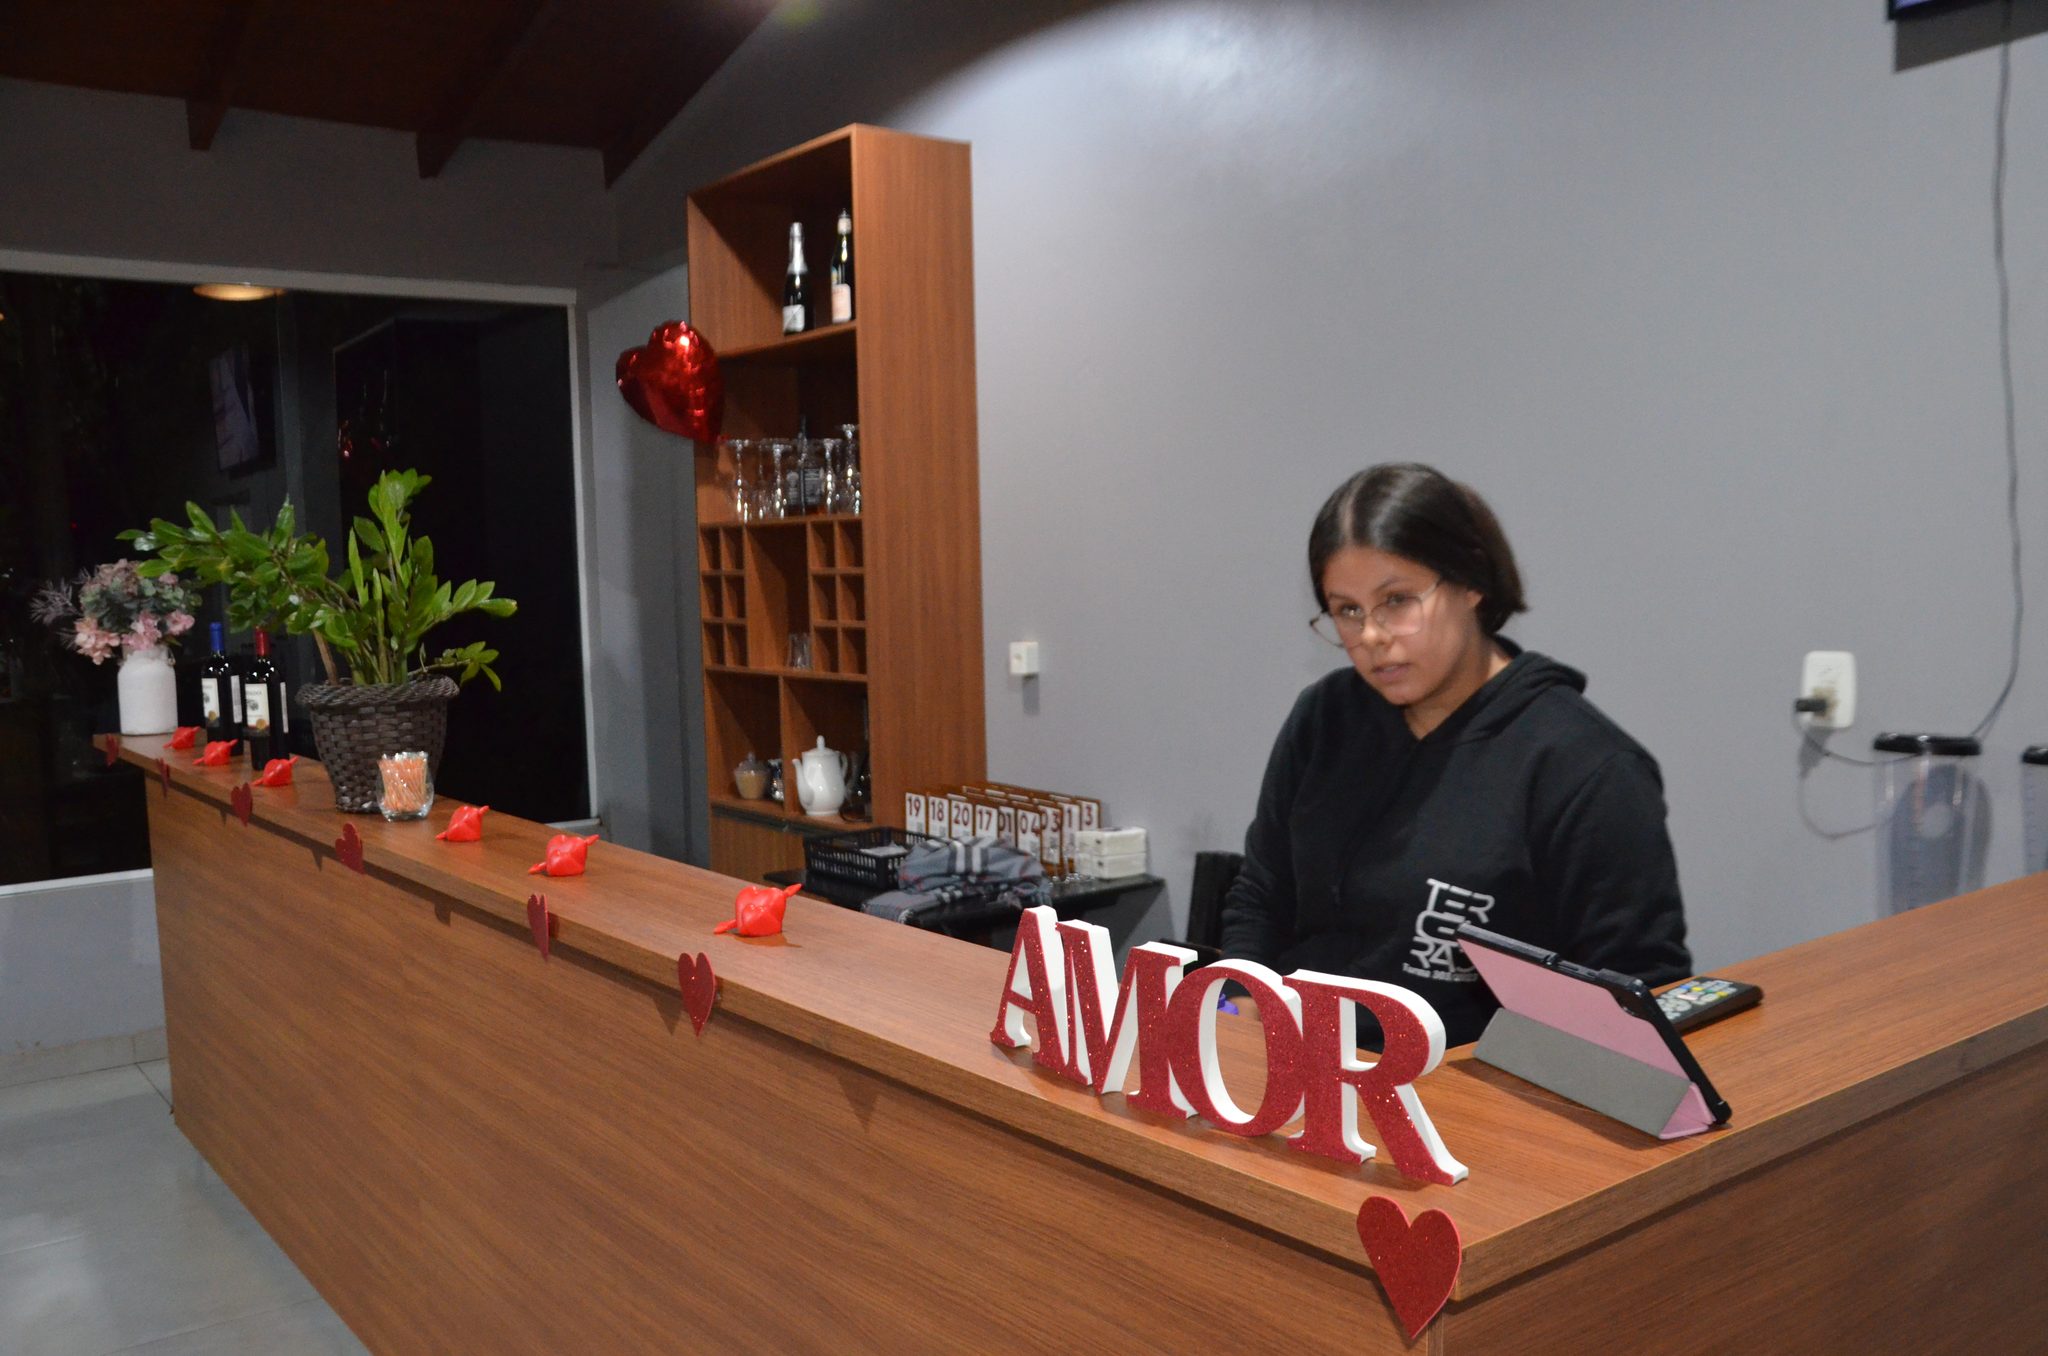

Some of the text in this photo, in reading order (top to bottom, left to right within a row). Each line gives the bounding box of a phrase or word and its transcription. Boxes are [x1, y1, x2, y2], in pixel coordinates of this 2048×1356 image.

[907, 797, 921, 817] 19
[931, 799, 945, 822] 18
[954, 804, 971, 827] 20
[978, 807, 993, 831] 17
[989, 905, 1469, 1186] AMOR
